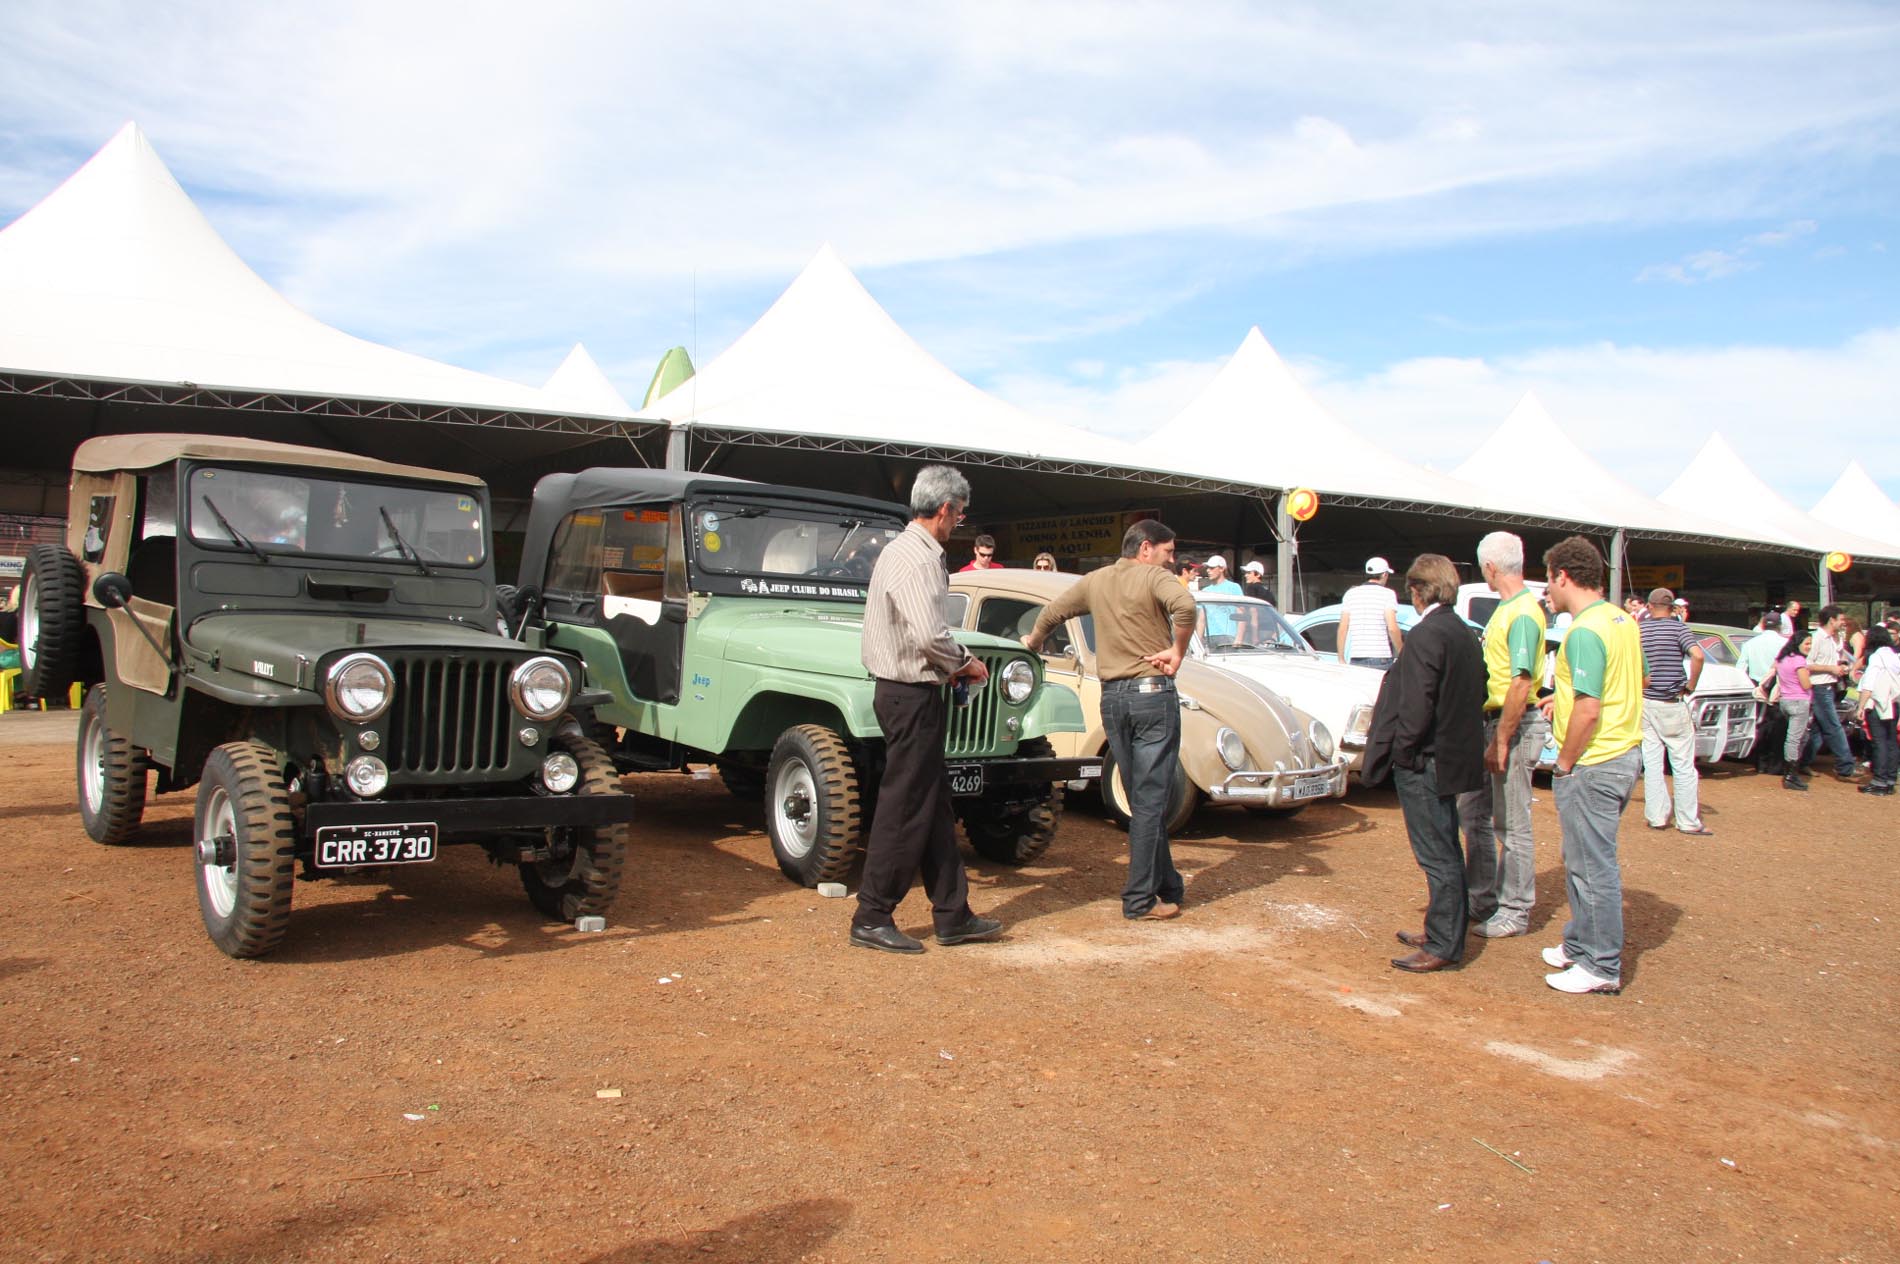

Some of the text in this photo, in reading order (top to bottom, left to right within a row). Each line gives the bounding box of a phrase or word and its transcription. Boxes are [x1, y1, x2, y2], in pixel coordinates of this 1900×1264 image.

[1060, 531, 1069, 540] A
[1072, 528, 1112, 540] LENHA
[770, 583, 860, 598] JEEP CLUBE DO BRASIL
[692, 673, 711, 687] Jeep
[952, 775, 980, 792] 4269
